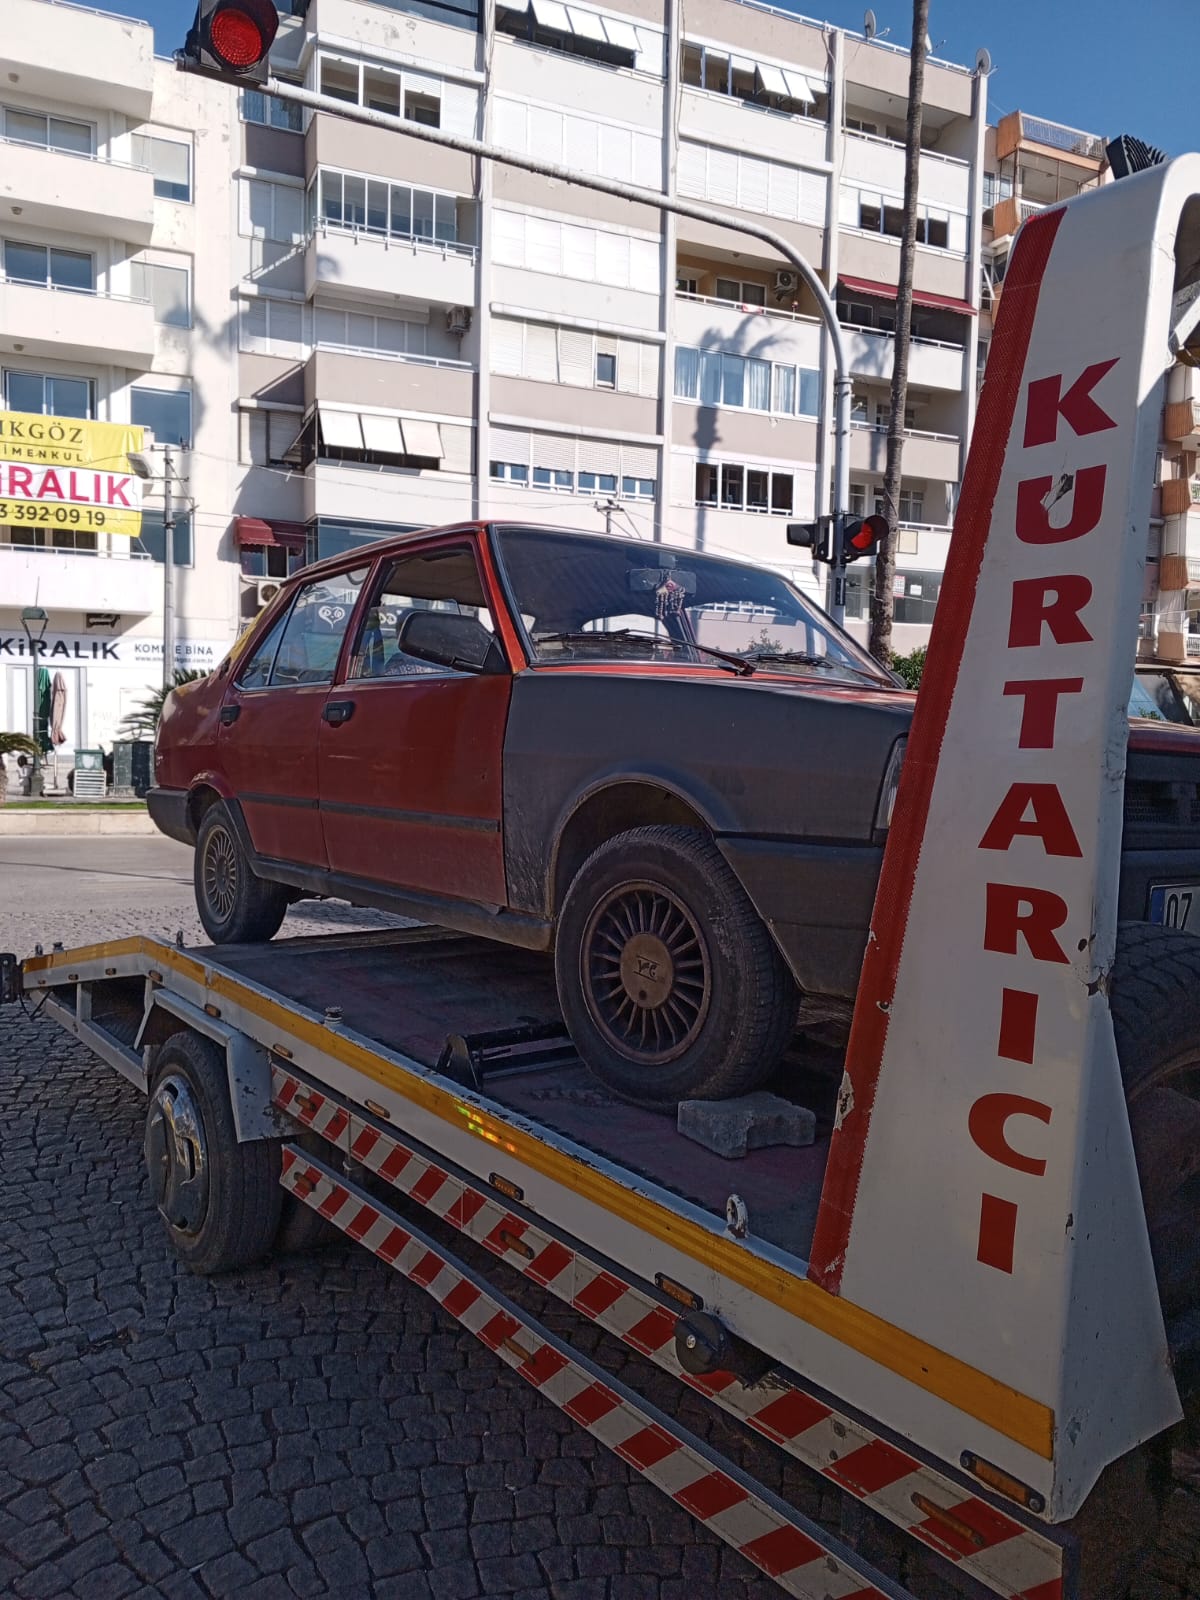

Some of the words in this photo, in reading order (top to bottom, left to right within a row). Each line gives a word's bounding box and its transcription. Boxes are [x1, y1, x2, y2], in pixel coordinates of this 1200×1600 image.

[14, 505, 49, 521] 392
[55, 508, 80, 524] 09
[86, 511, 105, 526] 19
[134, 644, 182, 654] KOME
[968, 357, 1120, 1275] KURTARICI
[1166, 893, 1193, 931] 07
